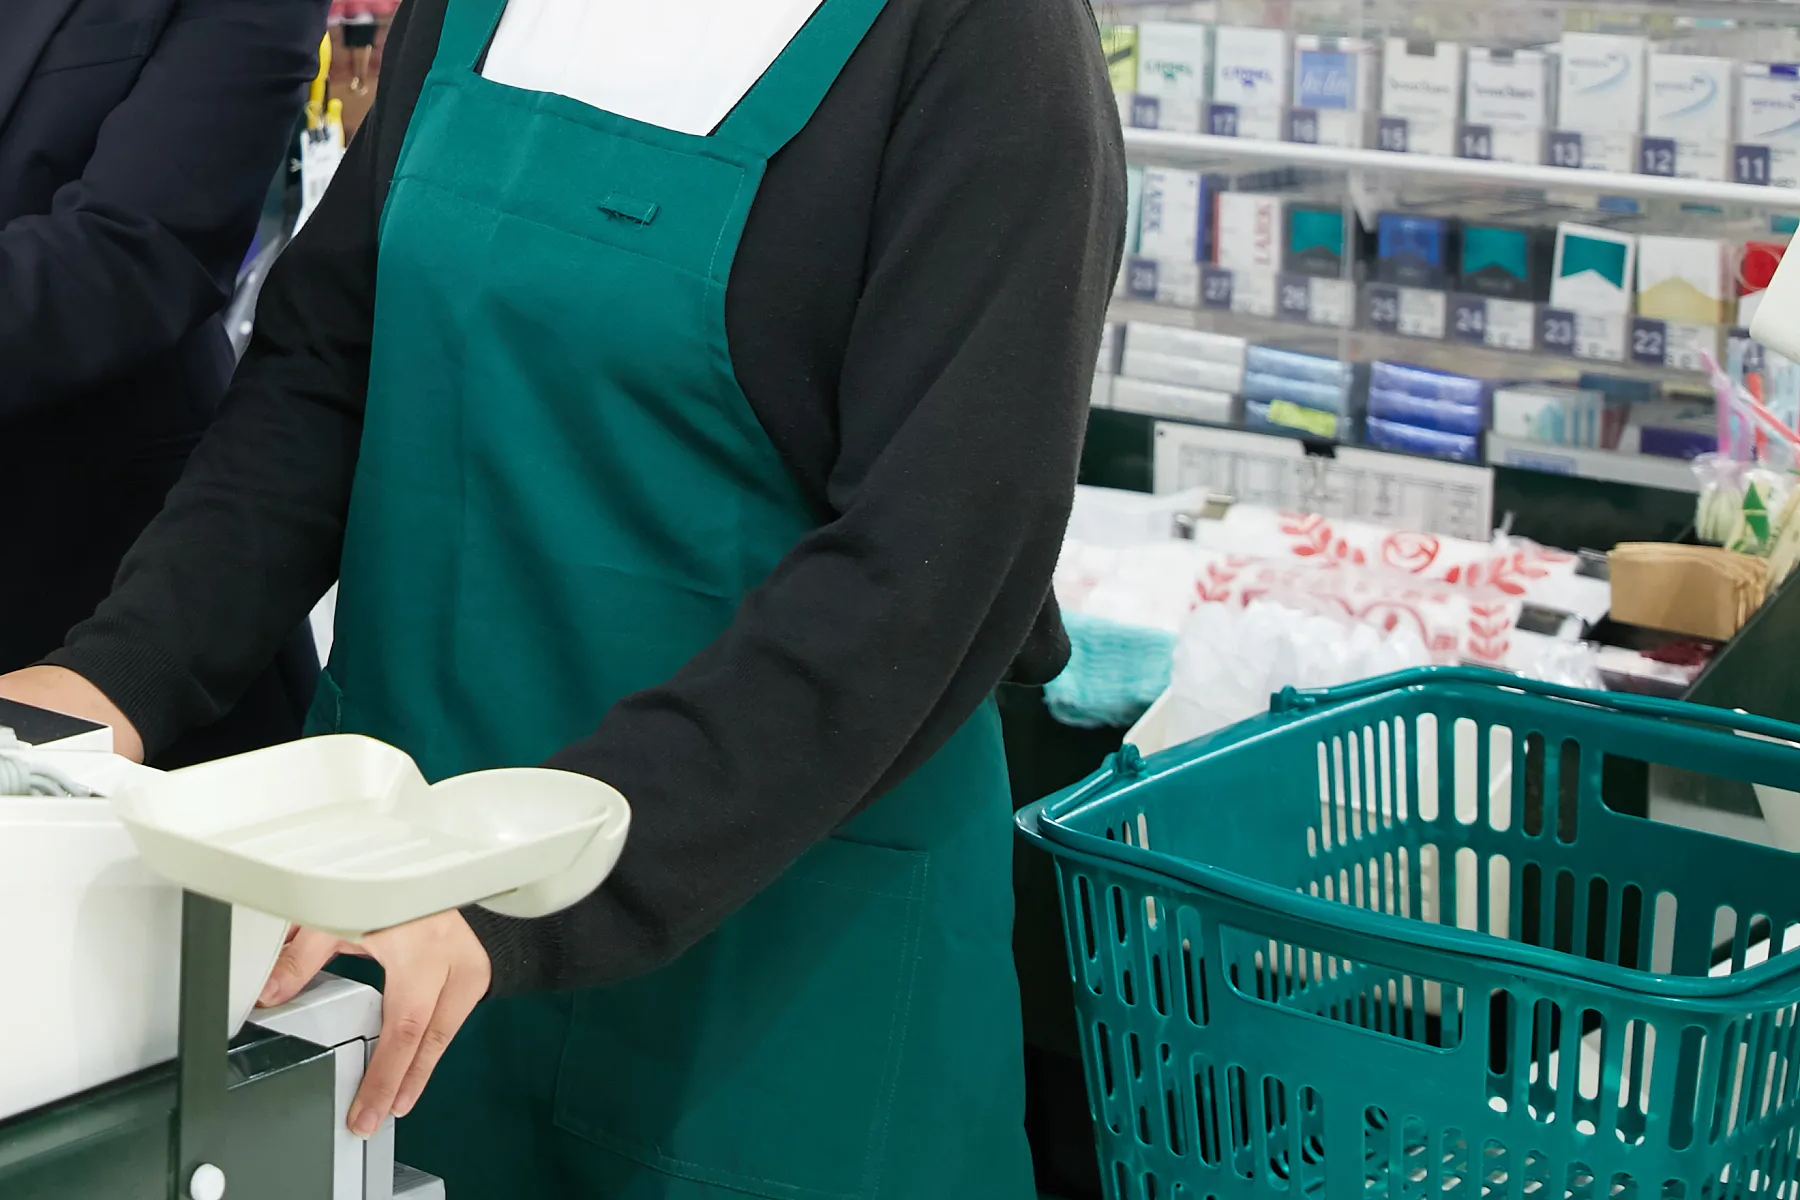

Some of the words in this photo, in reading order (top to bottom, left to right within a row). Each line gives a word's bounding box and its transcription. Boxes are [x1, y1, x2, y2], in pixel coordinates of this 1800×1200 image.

[1464, 134, 1489, 158] 14
[1553, 142, 1579, 167] 13
[1644, 150, 1672, 174] 12
[1739, 156, 1766, 181] 11
[1456, 308, 1483, 332] 24
[1545, 319, 1572, 344] 23
[1634, 329, 1662, 354] 22
